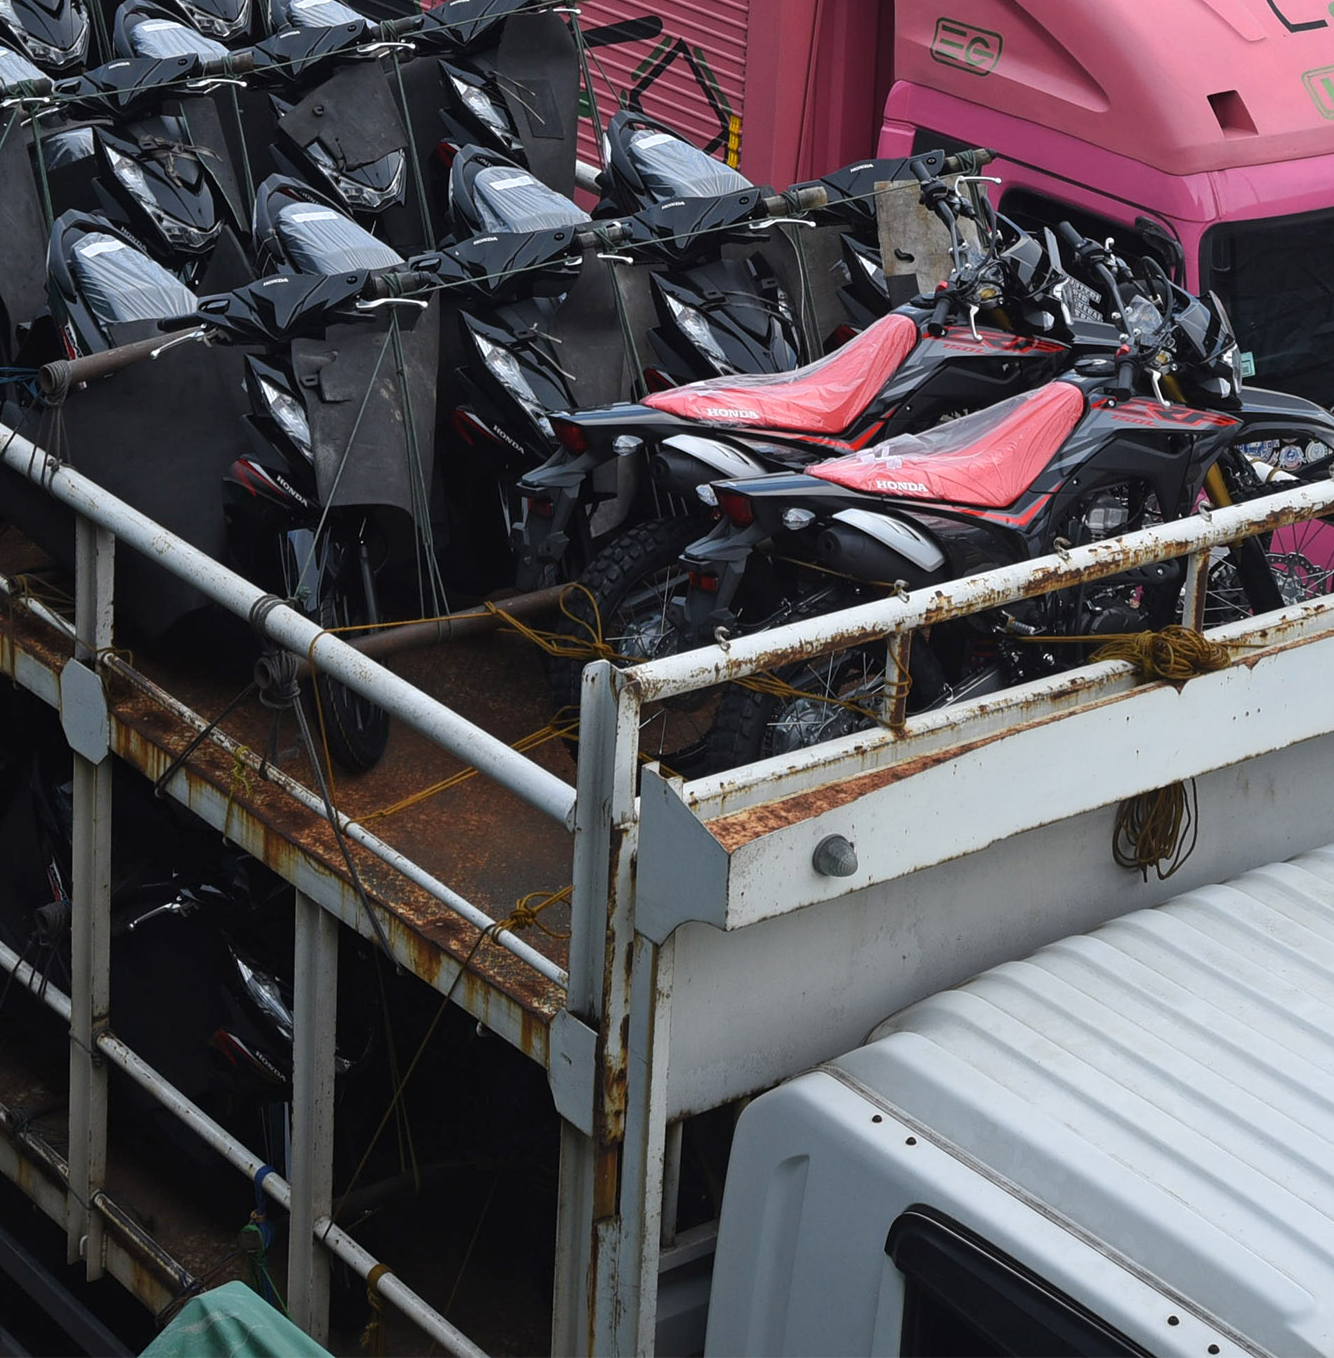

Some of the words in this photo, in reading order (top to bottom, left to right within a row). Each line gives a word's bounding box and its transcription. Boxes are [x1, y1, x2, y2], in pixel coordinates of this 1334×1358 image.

[120, 225, 148, 251] HONDA
[472, 236, 498, 245] HONDA
[263, 277, 289, 287] HONDA
[707, 407, 760, 419] HONDA
[492, 424, 526, 455] HONDA
[276, 474, 309, 507] HONDA
[875, 480, 929, 493] HONDA
[255, 1049, 286, 1083] HONDA
